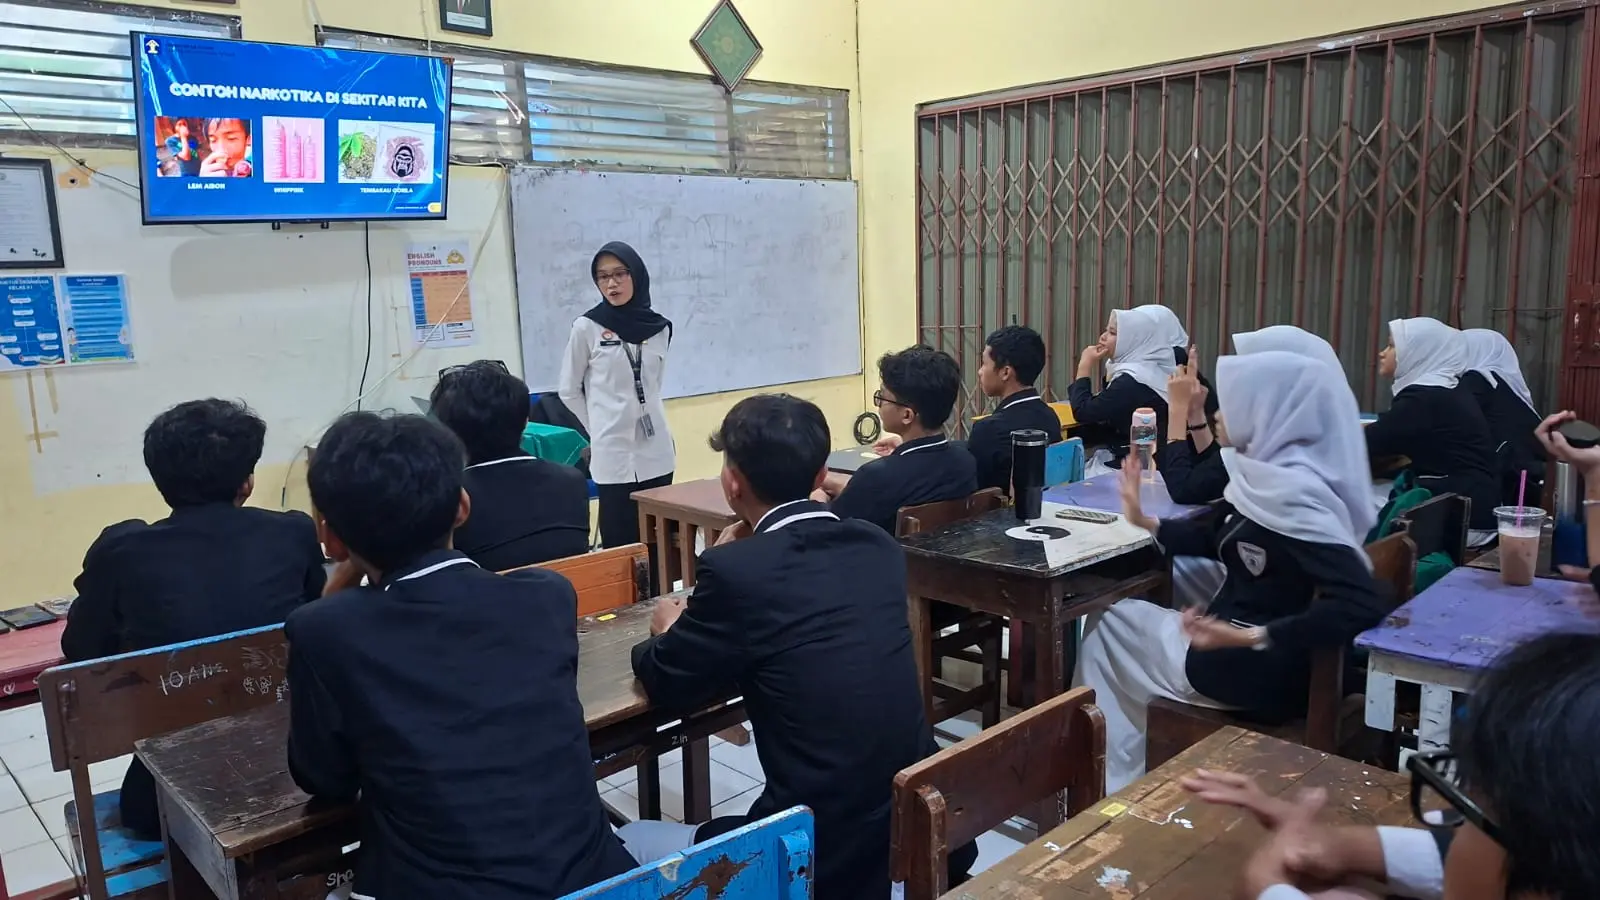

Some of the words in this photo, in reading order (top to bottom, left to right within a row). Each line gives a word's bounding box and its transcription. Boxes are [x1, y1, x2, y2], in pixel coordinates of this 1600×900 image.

[169, 82, 237, 98] CONTOH
[240, 86, 323, 103] NARKOTIKA
[325, 91, 339, 104] DI
[341, 92, 396, 107] SEKITAR
[397, 95, 428, 109] KITA
[408, 259, 442, 267] PRONOUNS
